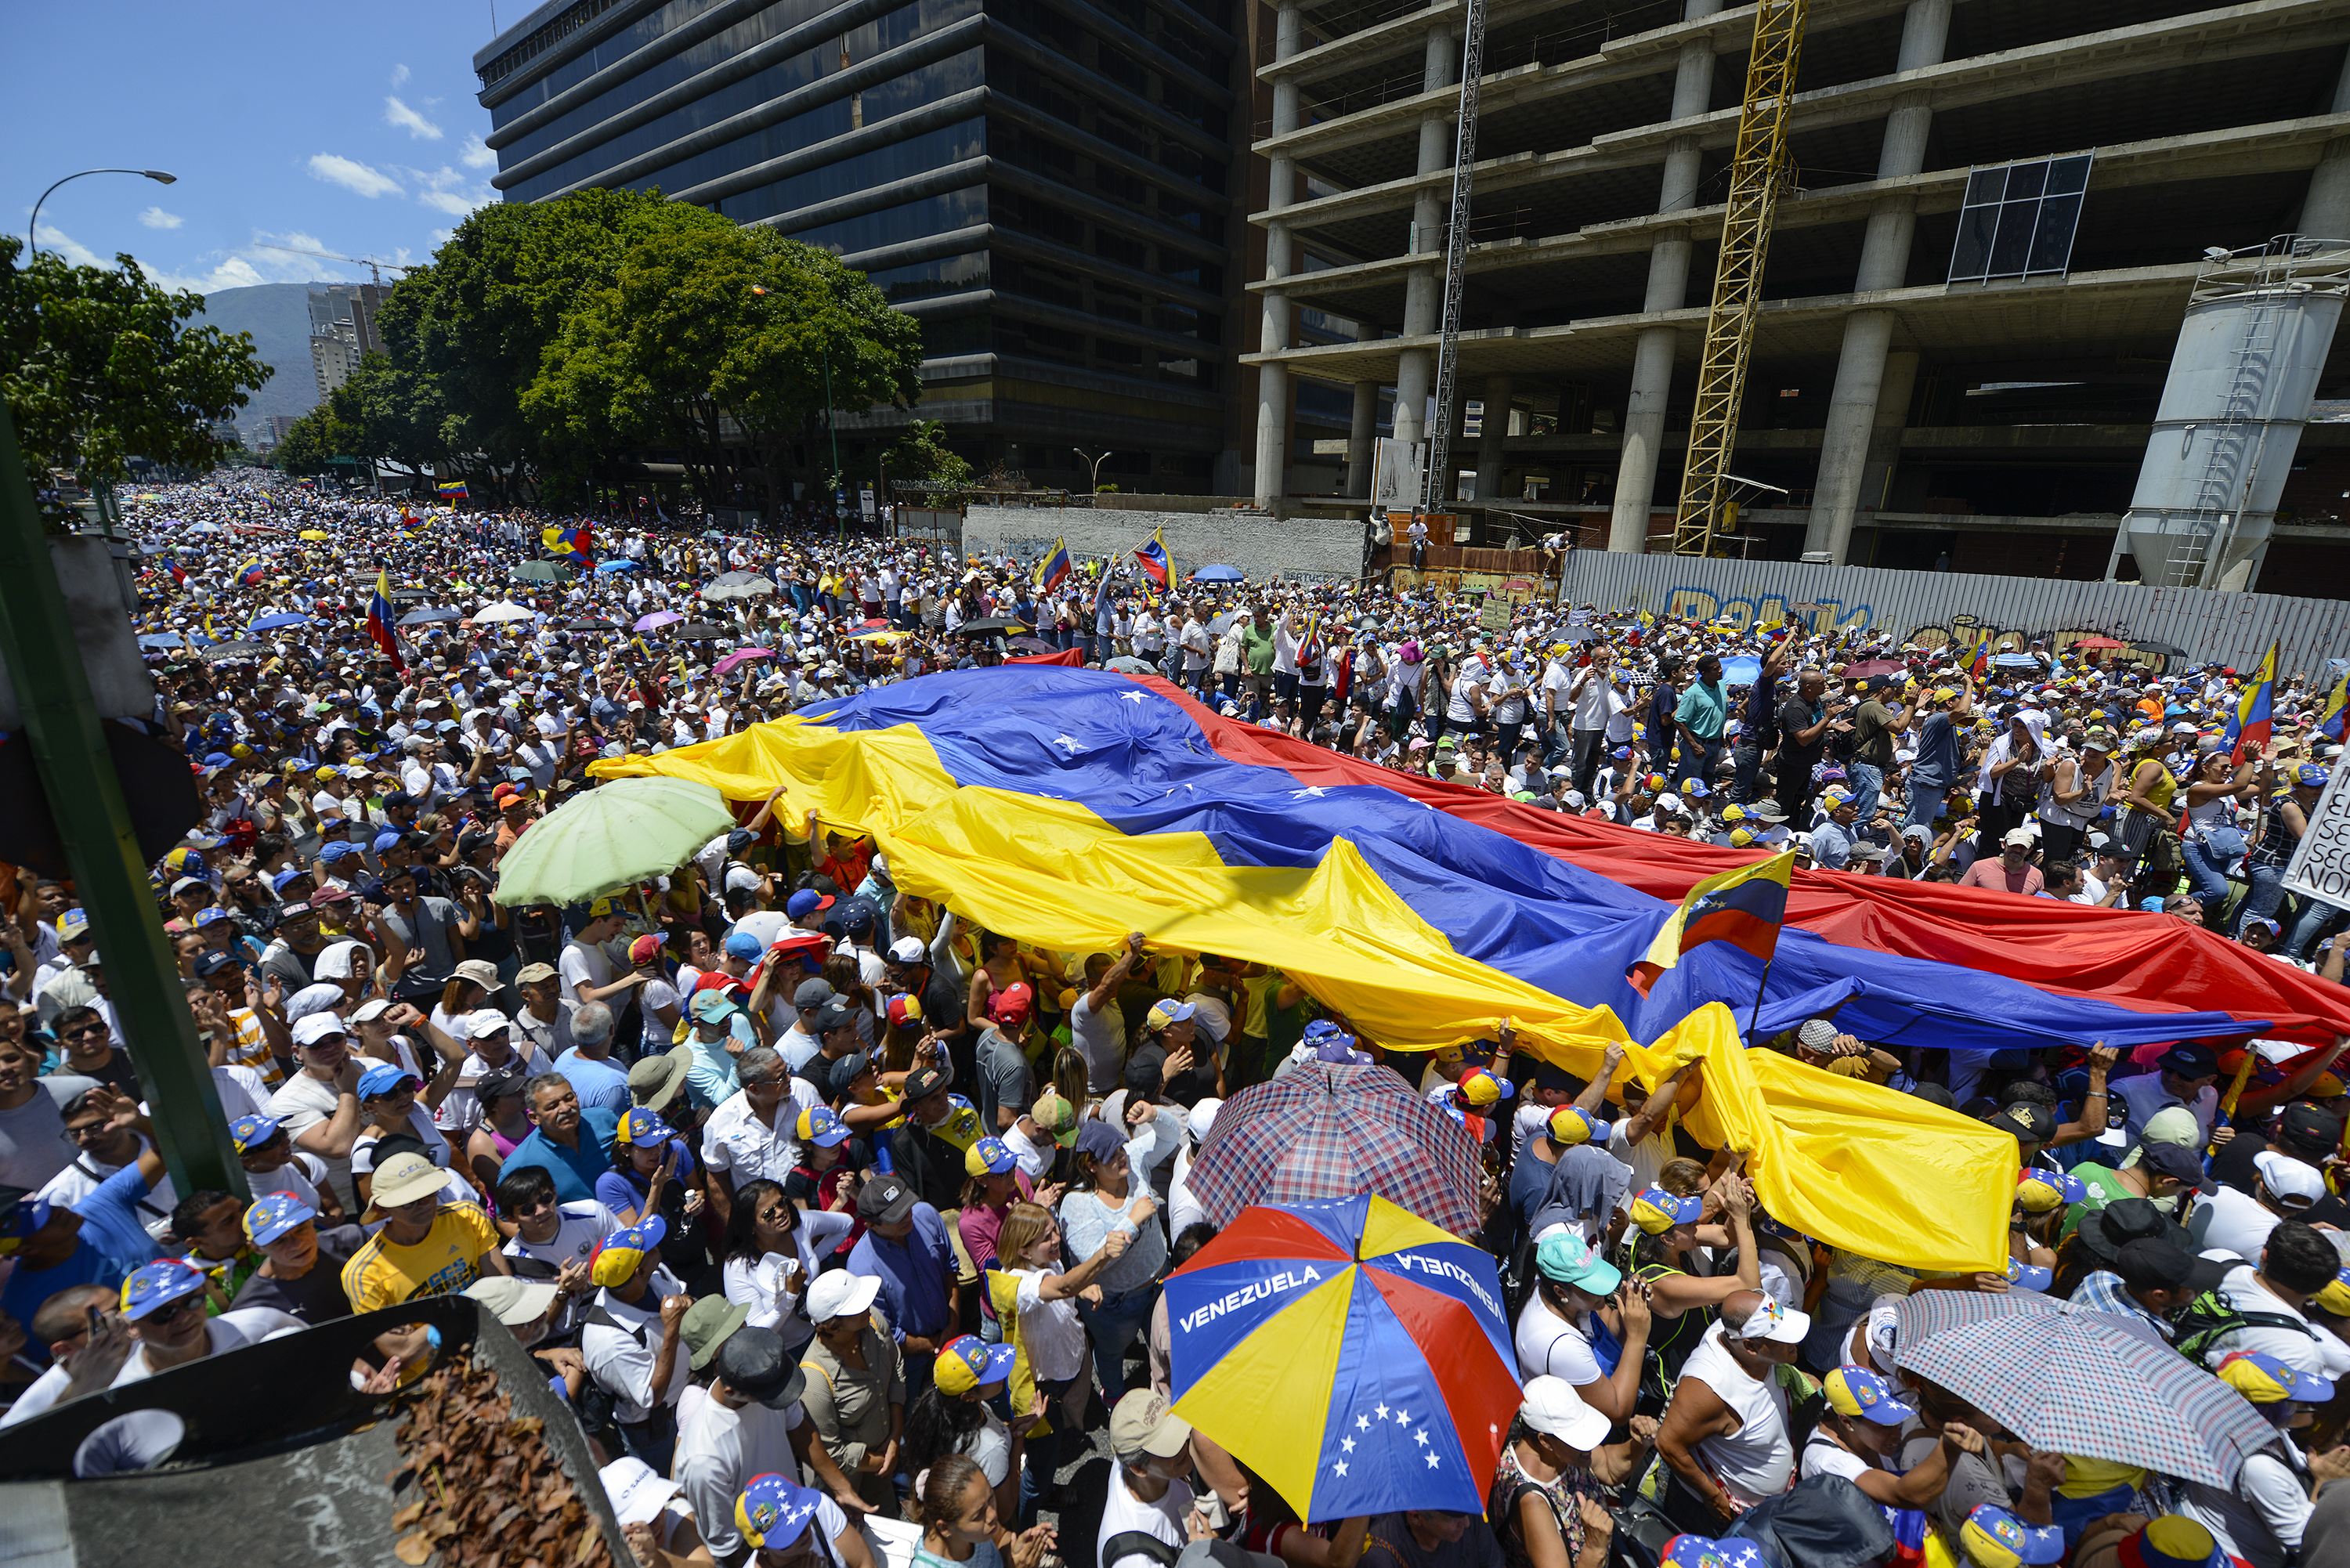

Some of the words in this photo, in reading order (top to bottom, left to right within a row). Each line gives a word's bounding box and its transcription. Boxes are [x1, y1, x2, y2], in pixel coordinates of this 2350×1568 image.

[2202, 594, 2257, 624] 28
[428, 1257, 467, 1288] CCS
[1394, 1252, 1505, 1325] VENEZUELA
[1179, 1265, 1321, 1334] VENEZUELA
